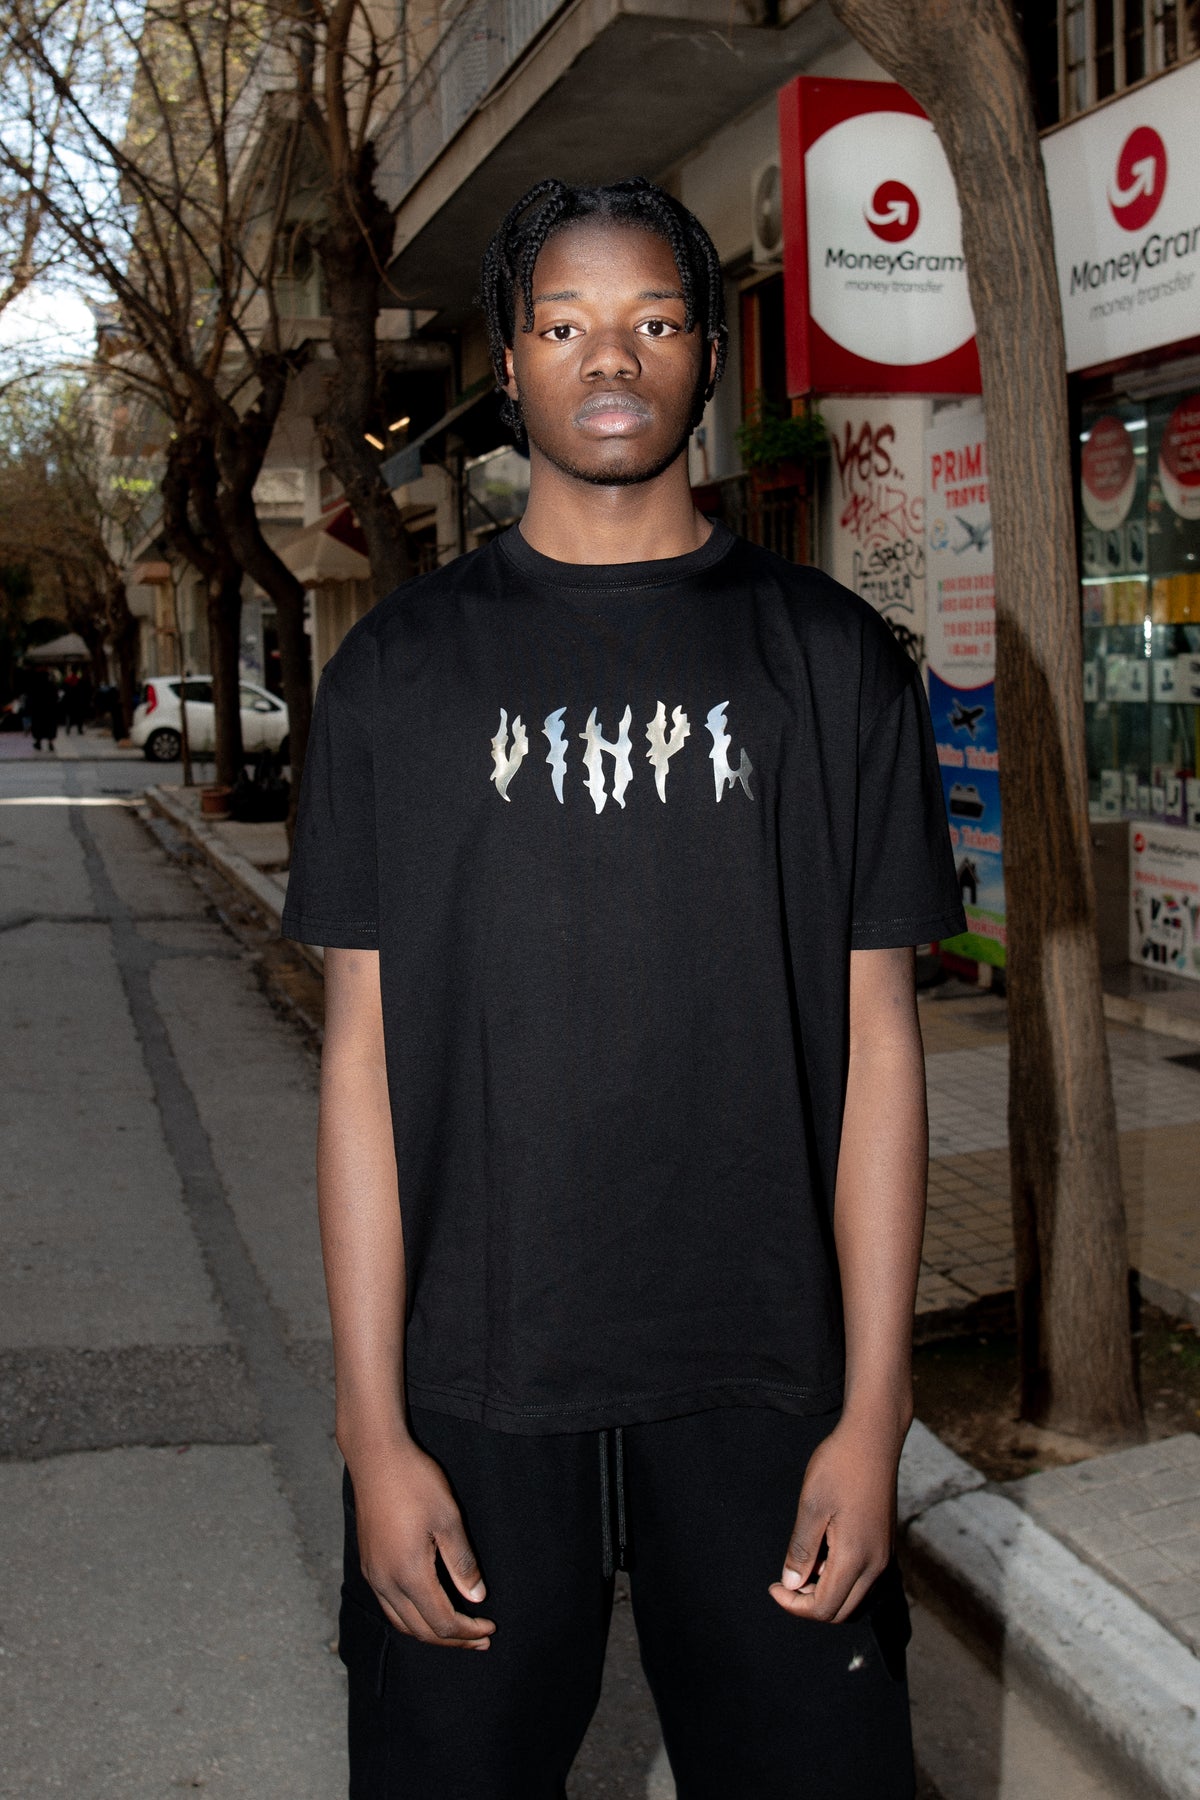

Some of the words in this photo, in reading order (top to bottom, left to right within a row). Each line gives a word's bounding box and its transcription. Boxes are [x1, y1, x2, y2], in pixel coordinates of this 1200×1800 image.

[825, 248, 965, 275] MoneyGram
[845, 281, 888, 294] money
[892, 280, 943, 293] transfer
[1089, 295, 1133, 321] money
[1137, 271, 1194, 305] transfer
[931, 443, 986, 491] PRIM
[945, 484, 988, 509] TRAVE
[490, 700, 754, 814] VINYL
